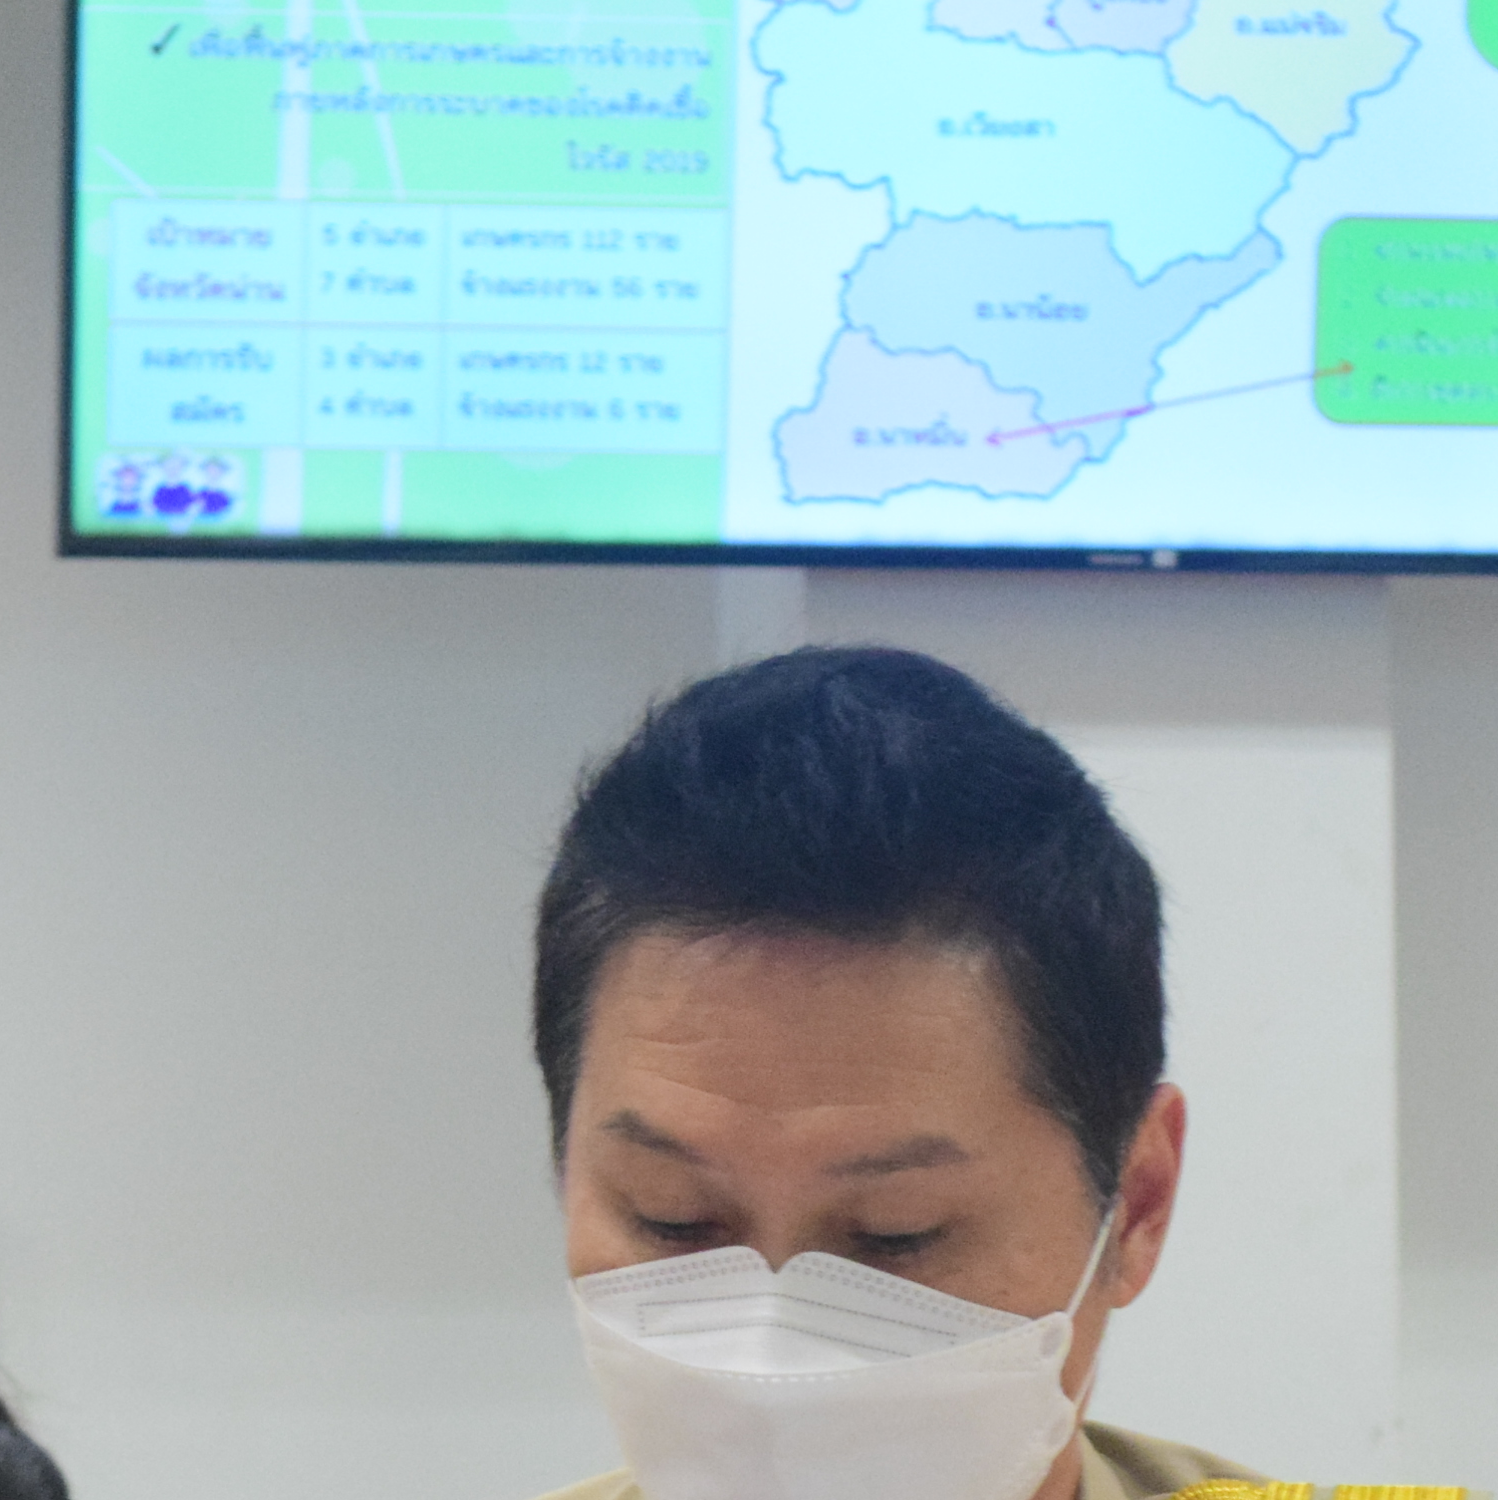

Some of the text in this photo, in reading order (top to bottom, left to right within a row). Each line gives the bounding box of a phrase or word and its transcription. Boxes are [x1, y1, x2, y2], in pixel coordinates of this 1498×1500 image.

[643, 150, 712, 176] 2019
[322, 219, 428, 249] 5 อำเภอ
[582, 228, 625, 253] 112
[321, 269, 338, 295] 7
[346, 341, 425, 372] อำเภอ
